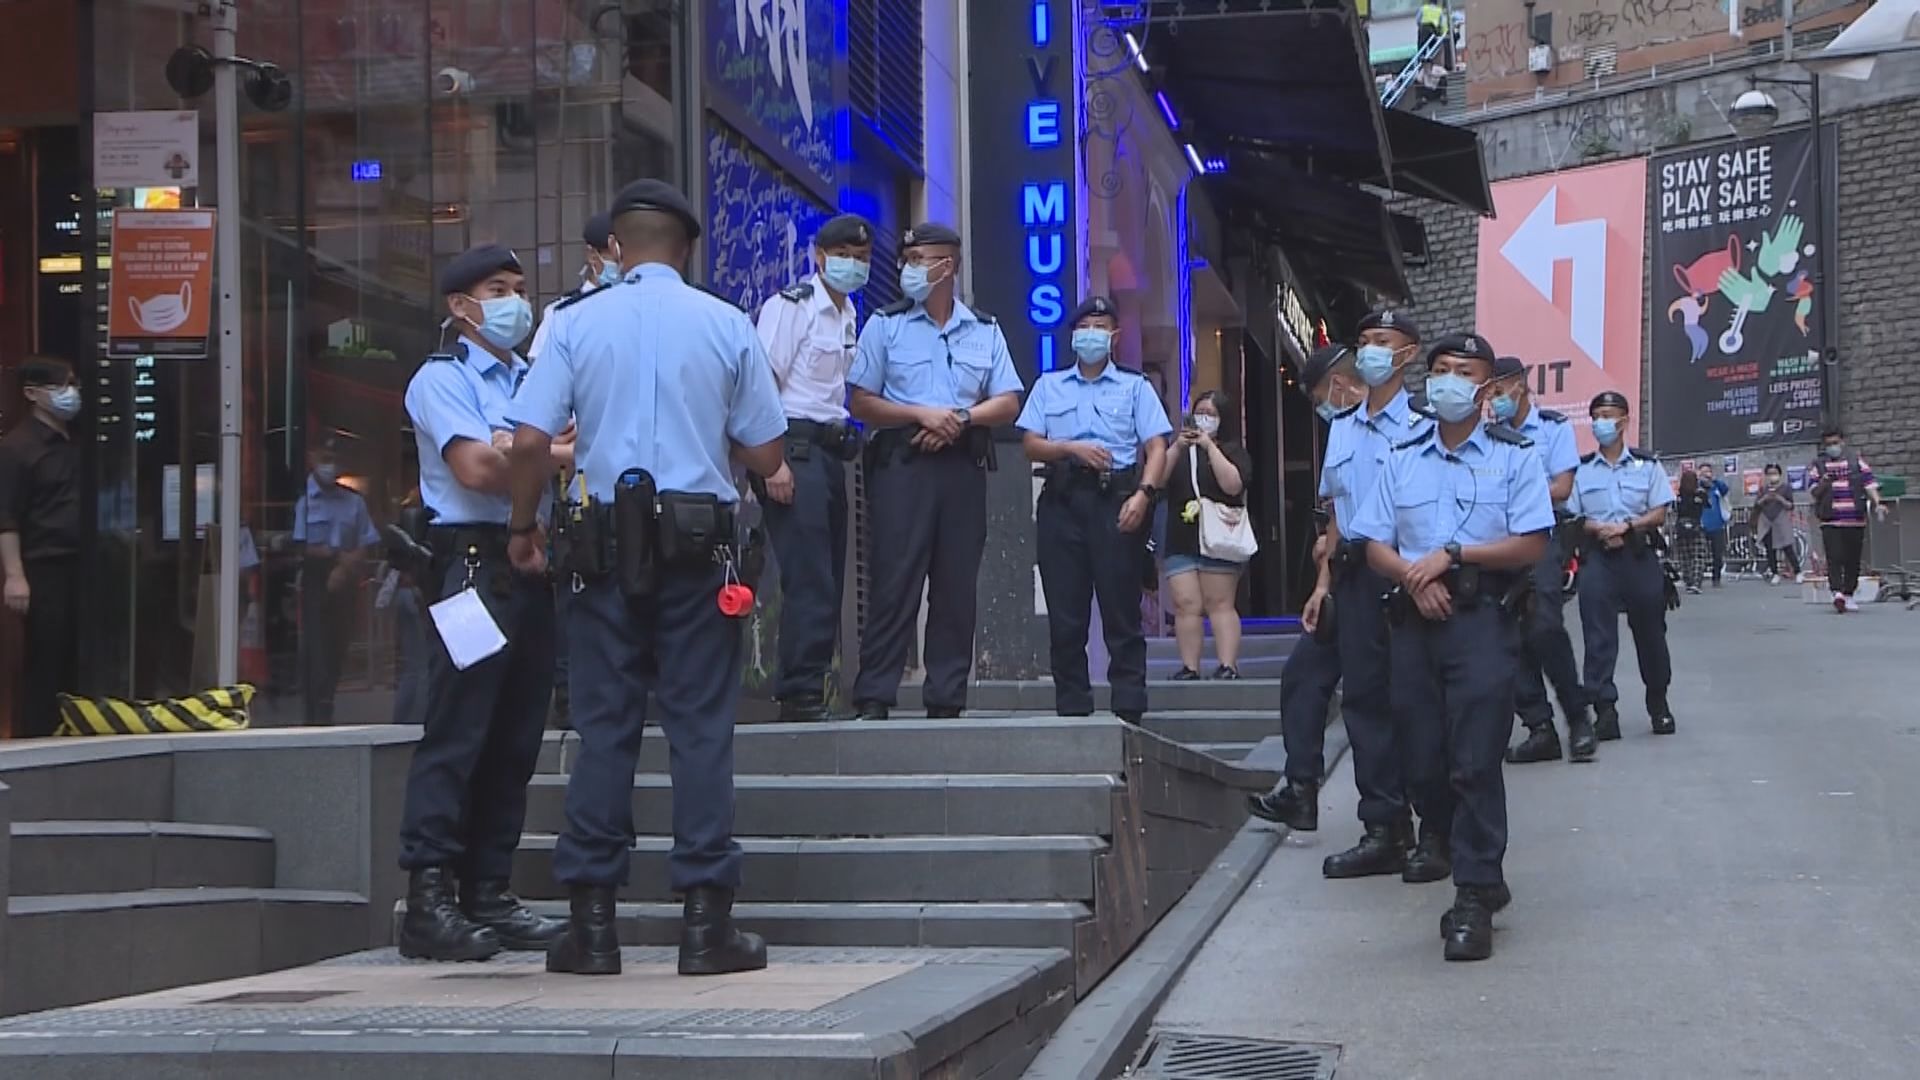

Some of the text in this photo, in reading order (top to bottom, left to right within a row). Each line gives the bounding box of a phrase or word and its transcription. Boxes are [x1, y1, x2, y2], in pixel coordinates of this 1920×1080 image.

[1662, 146, 1771, 189] STAY SAFE
[1662, 175, 1772, 217] PLAY SAFE
[1707, 396, 1758, 411] TEMPERATURE
[1723, 386, 1758, 400] MEASURE
